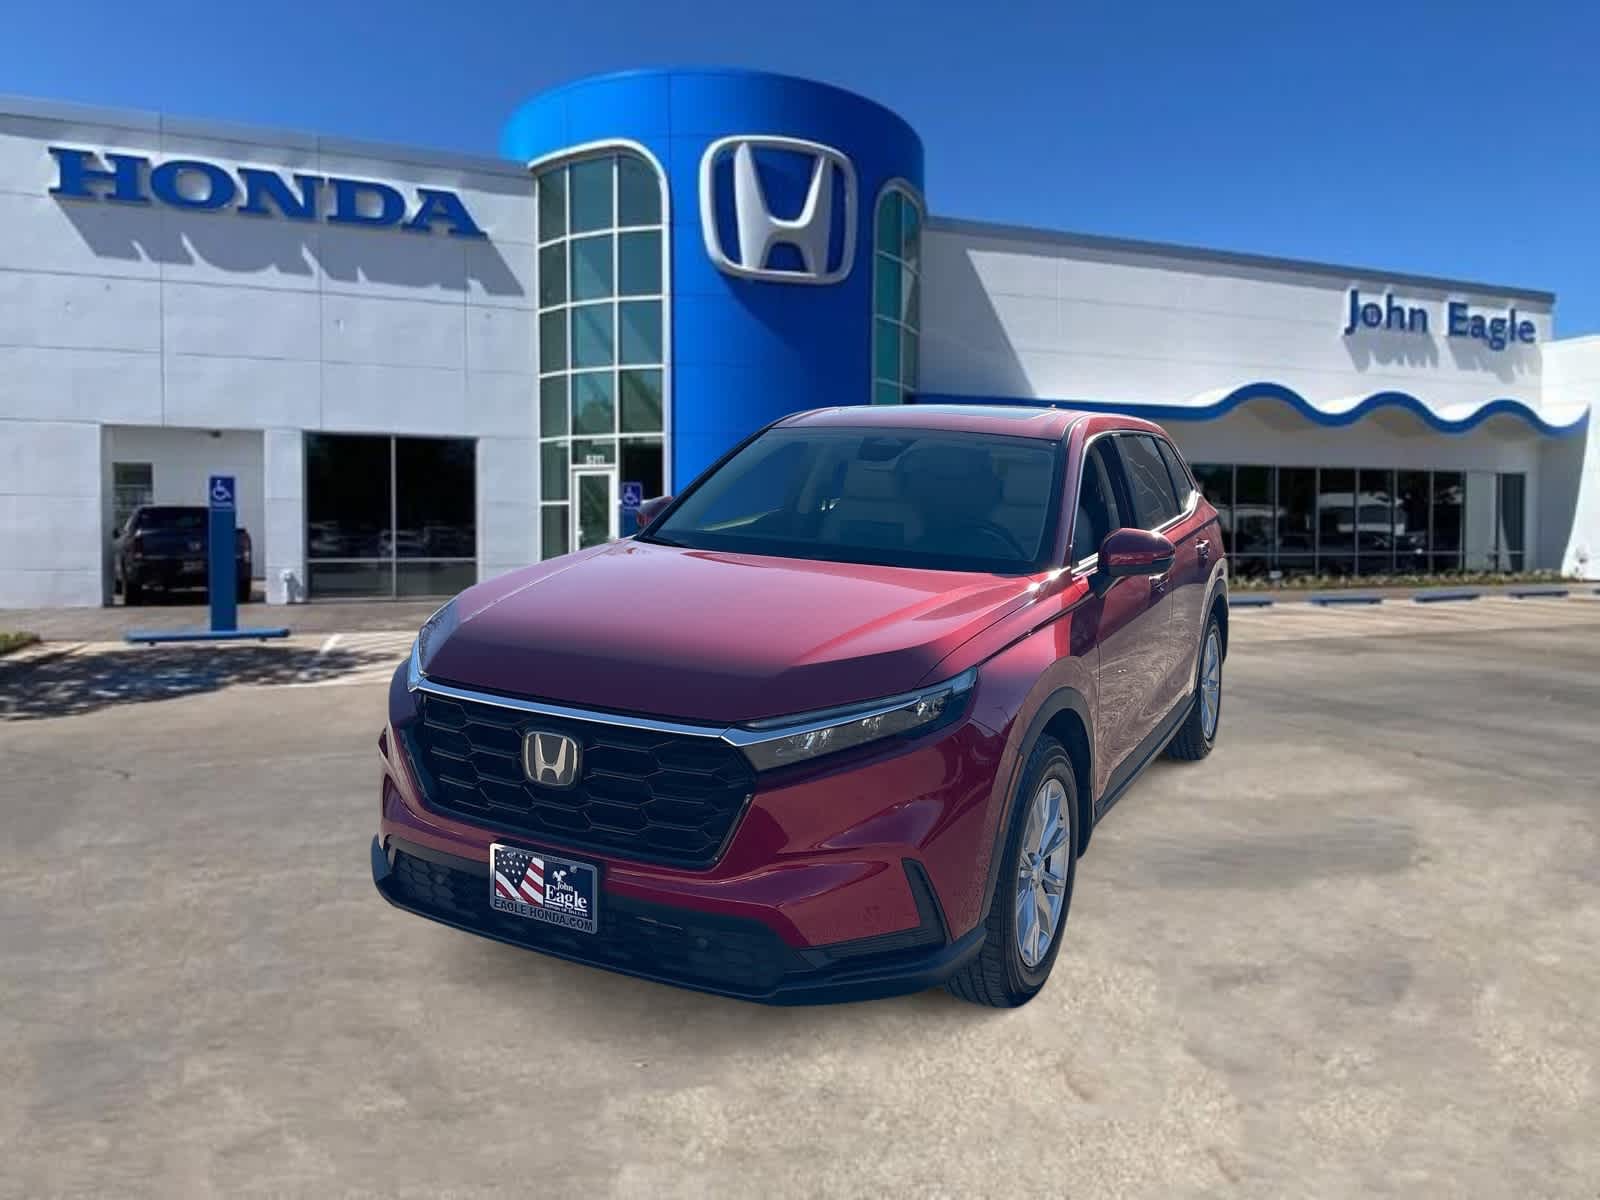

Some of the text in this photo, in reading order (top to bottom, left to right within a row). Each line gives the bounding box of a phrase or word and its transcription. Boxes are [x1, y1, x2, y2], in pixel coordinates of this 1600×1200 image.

[48, 146, 489, 239] HONDA
[1344, 289, 1536, 351] John Eagle
[544, 884, 588, 910] Eagle
[556, 881, 574, 893] John
[494, 897, 528, 915] EAGLE
